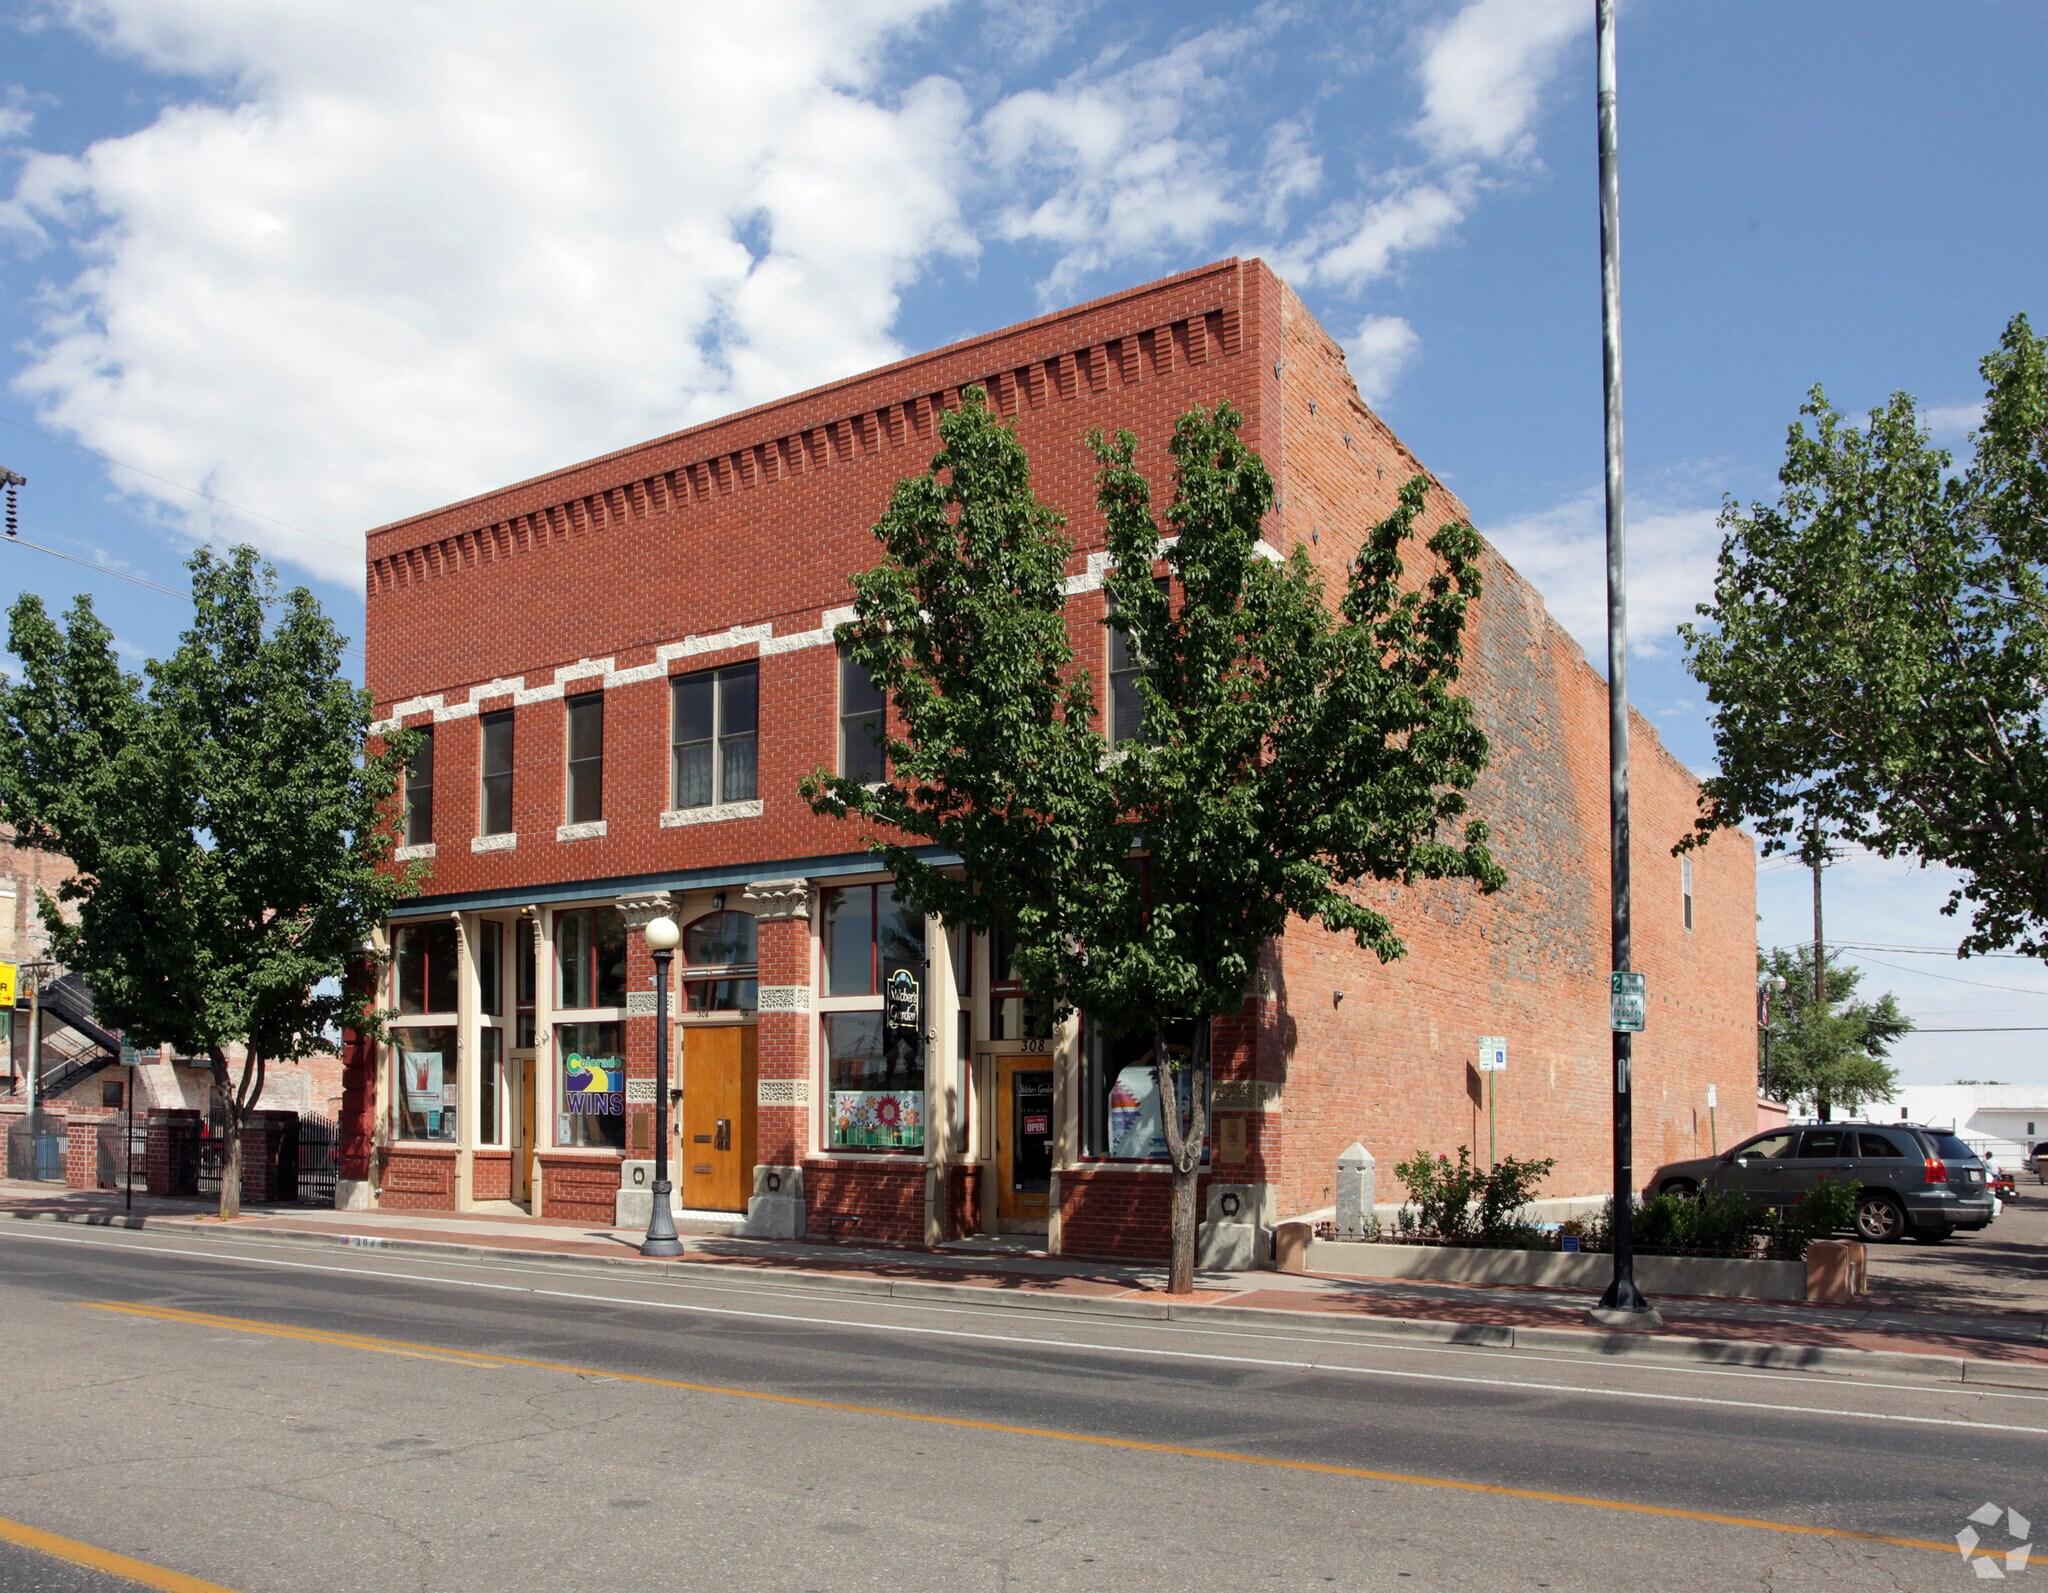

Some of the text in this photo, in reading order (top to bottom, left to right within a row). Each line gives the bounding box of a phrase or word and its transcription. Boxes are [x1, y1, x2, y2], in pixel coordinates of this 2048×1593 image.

[1613, 976, 1621, 992] 2
[890, 1003, 917, 1025] Garden
[1021, 1039, 1045, 1052] 308
[566, 1052, 622, 1075] Colorado
[566, 1093, 625, 1116] WINS
[1026, 1123, 1045, 1132] OPEN
